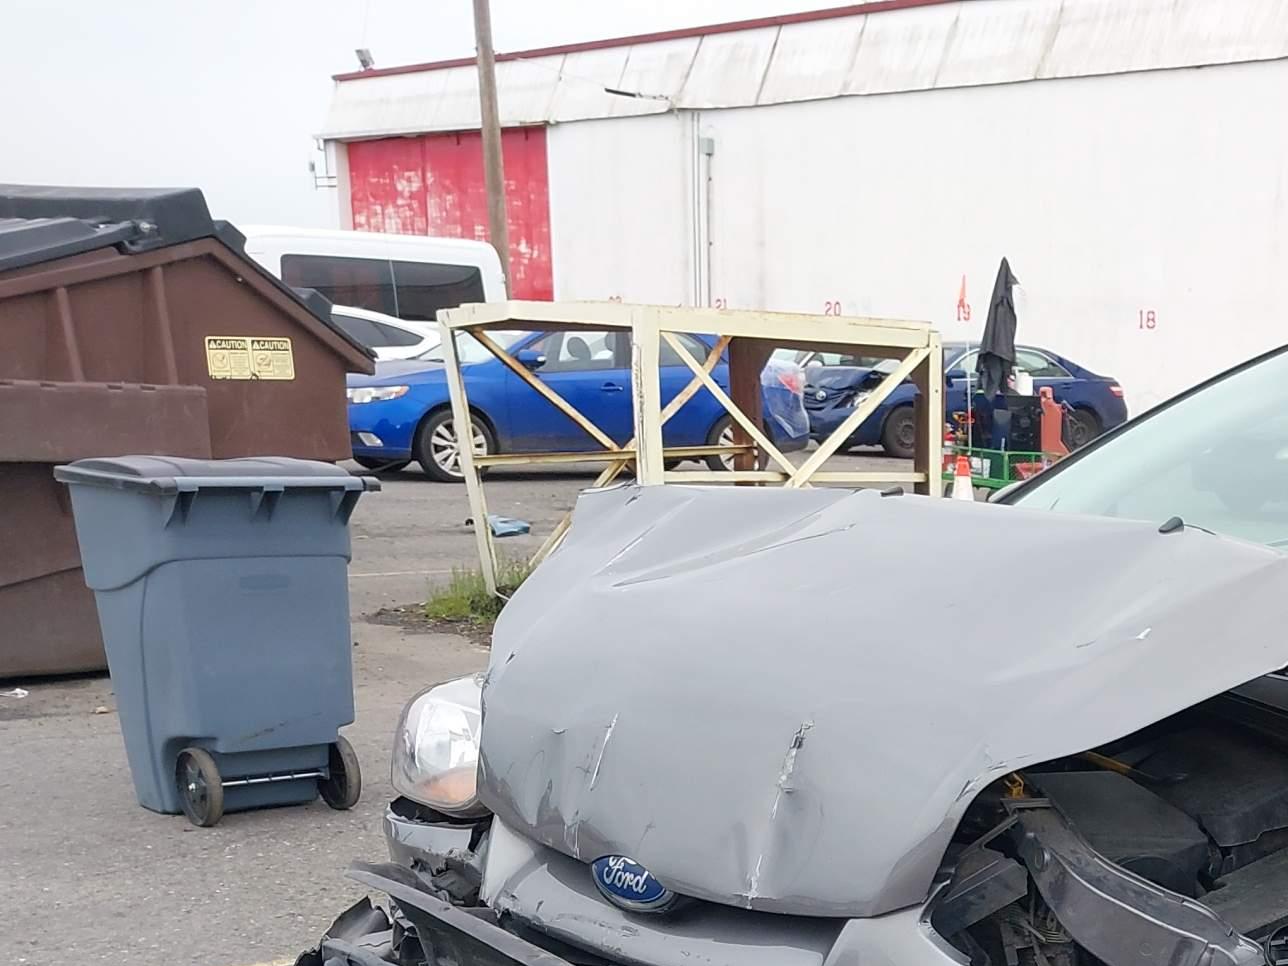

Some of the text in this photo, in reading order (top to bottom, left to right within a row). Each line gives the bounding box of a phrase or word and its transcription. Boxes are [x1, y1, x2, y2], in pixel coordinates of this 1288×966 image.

[825, 301, 841, 317] 20
[957, 302, 971, 321] 19
[1139, 310, 1156, 329] 18
[216, 340, 248, 349] CAUTION
[260, 341, 290, 350] CAUTION
[603, 856, 647, 894] Ford
